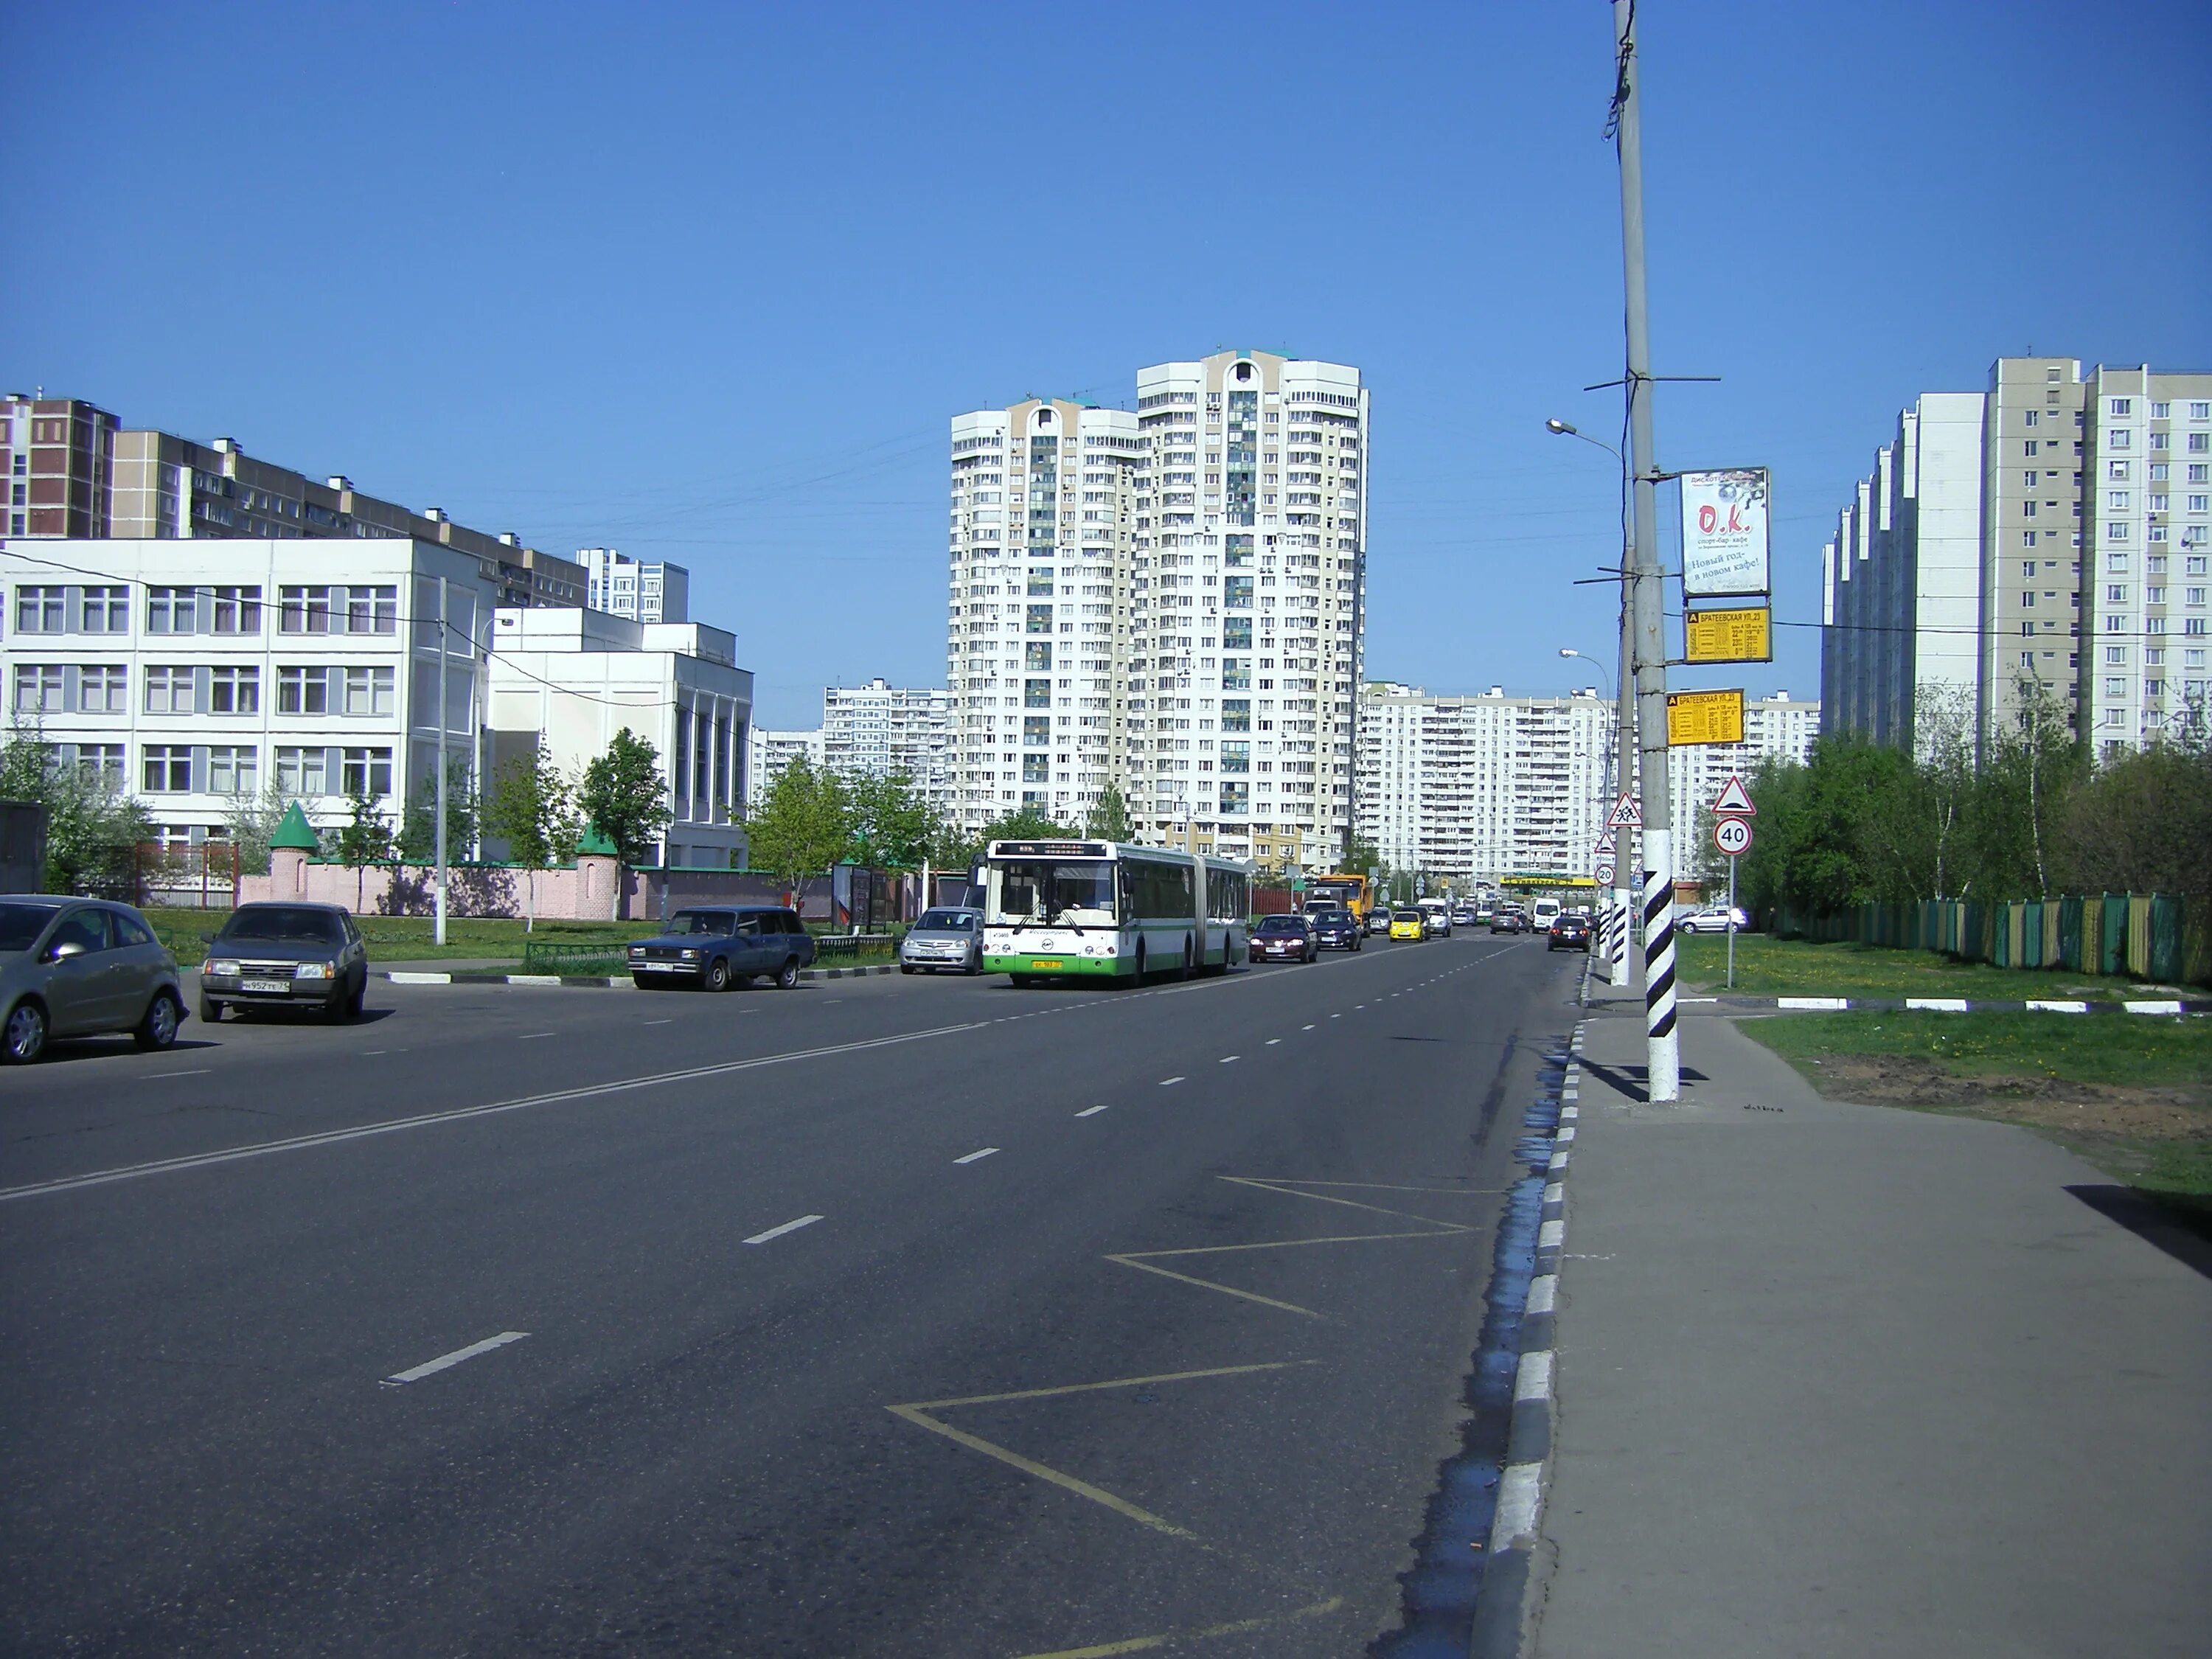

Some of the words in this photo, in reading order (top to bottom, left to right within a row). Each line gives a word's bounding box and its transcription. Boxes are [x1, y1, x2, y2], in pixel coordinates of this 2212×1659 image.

[1691, 554, 1724, 569] Новый
[1694, 573, 1700, 581] в
[1703, 566, 1731, 579] новом
[1733, 557, 1760, 571] кафе!
[1721, 827, 1744, 843] 40
[1600, 870, 1611, 879] 20
